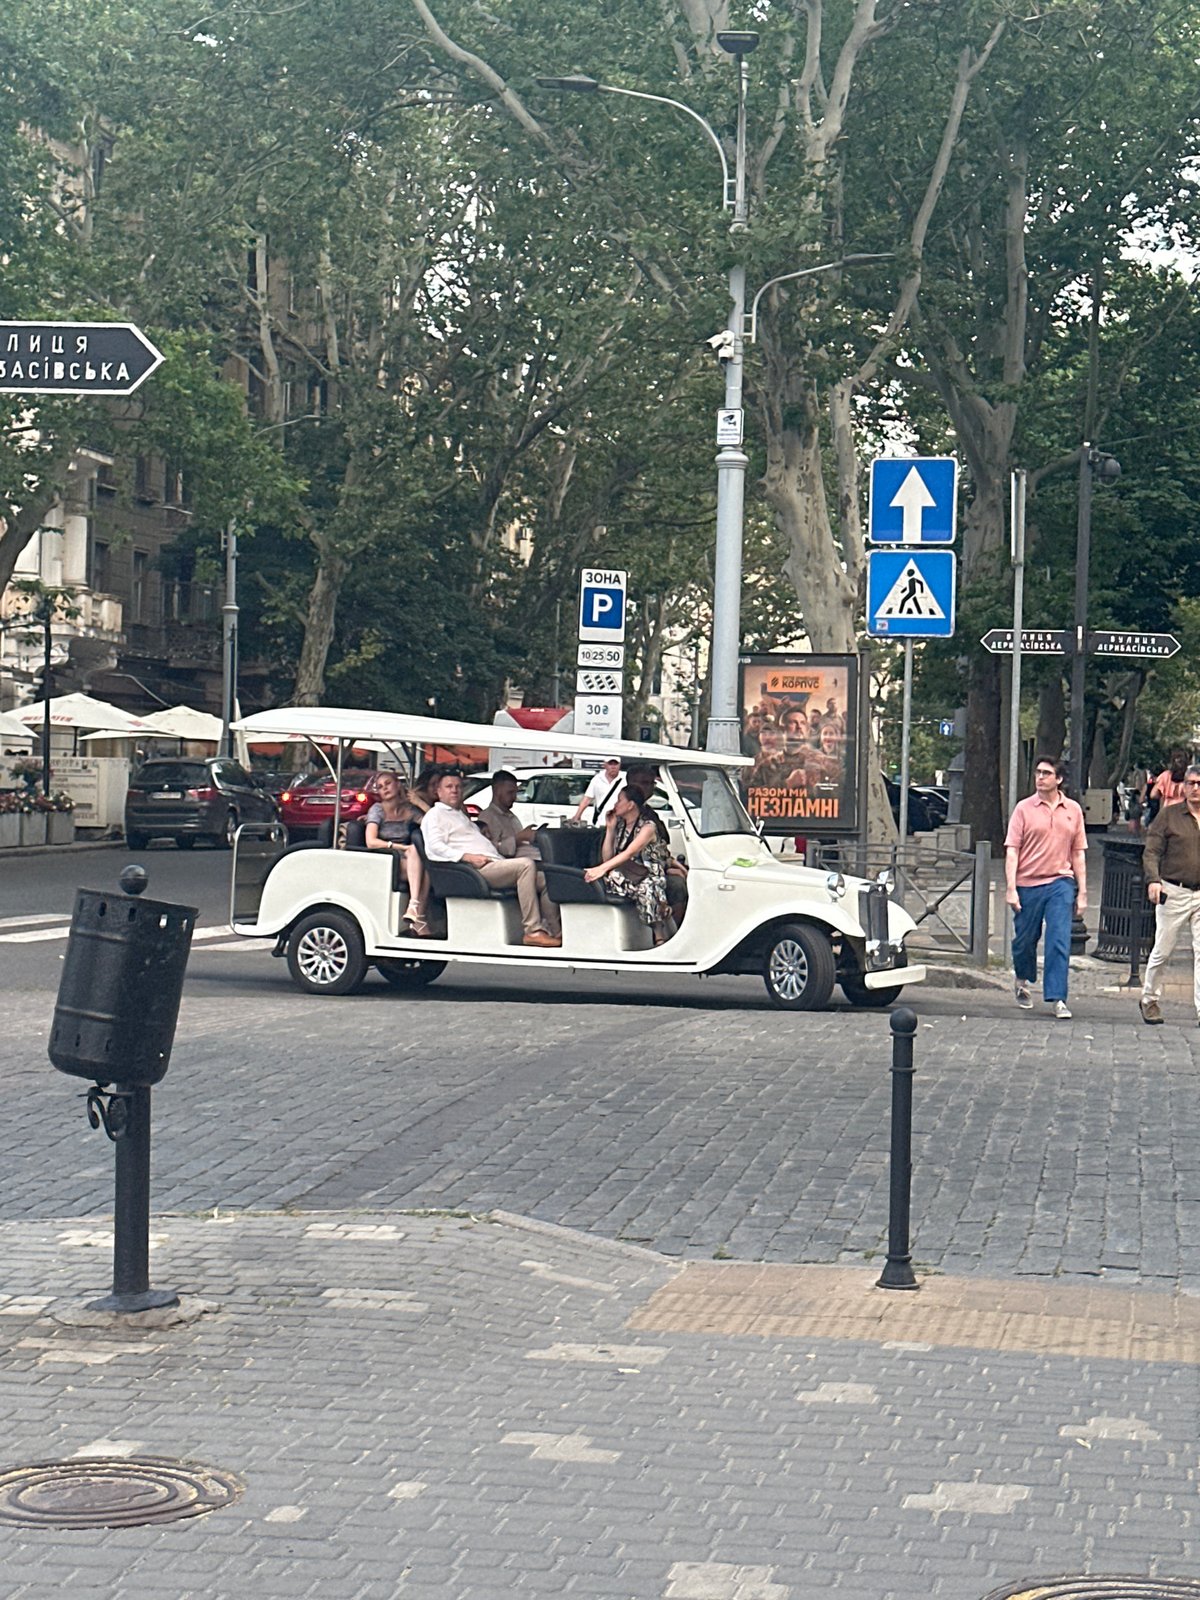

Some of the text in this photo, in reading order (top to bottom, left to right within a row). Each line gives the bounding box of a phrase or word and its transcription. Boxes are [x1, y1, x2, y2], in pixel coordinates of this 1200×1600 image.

[585, 571, 621, 585] ЗОНА
[1006, 633, 1052, 641] ВЛИЦЯ
[1110, 635, 1156, 645] ВУЛИЦЯ
[991, 640, 1062, 650] ДЕРИАСІВСЬКА
[581, 651, 620, 661] 10 25 50
[748, 787, 808, 797] РАЗОМ МИ
[748, 797, 839, 818] НЕЗЛАМНІ
